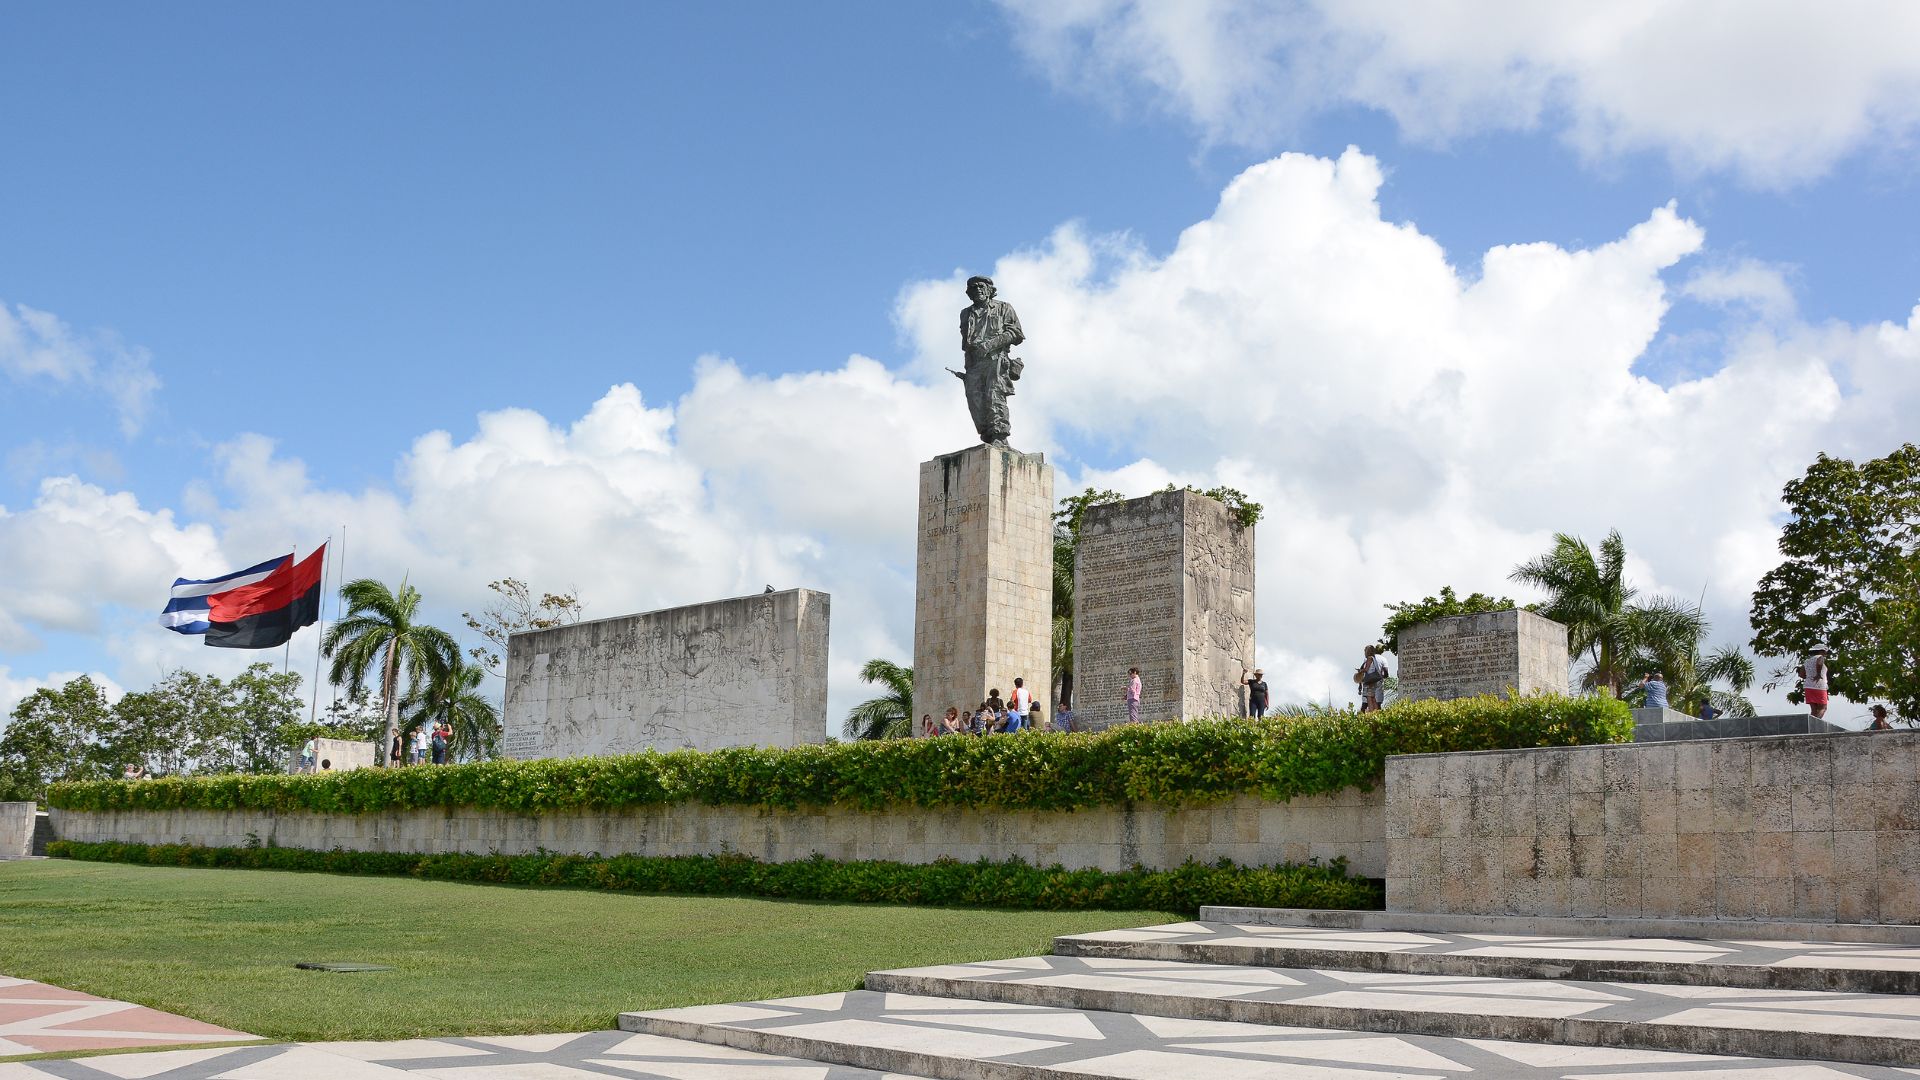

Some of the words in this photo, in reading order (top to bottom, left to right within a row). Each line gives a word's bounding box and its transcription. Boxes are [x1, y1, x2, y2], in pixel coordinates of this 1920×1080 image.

[928, 492, 953, 504] HASA
[927, 512, 937, 521] LA
[943, 503, 982, 516] VICTORIA
[926, 525, 960, 537] SIEMPRE
